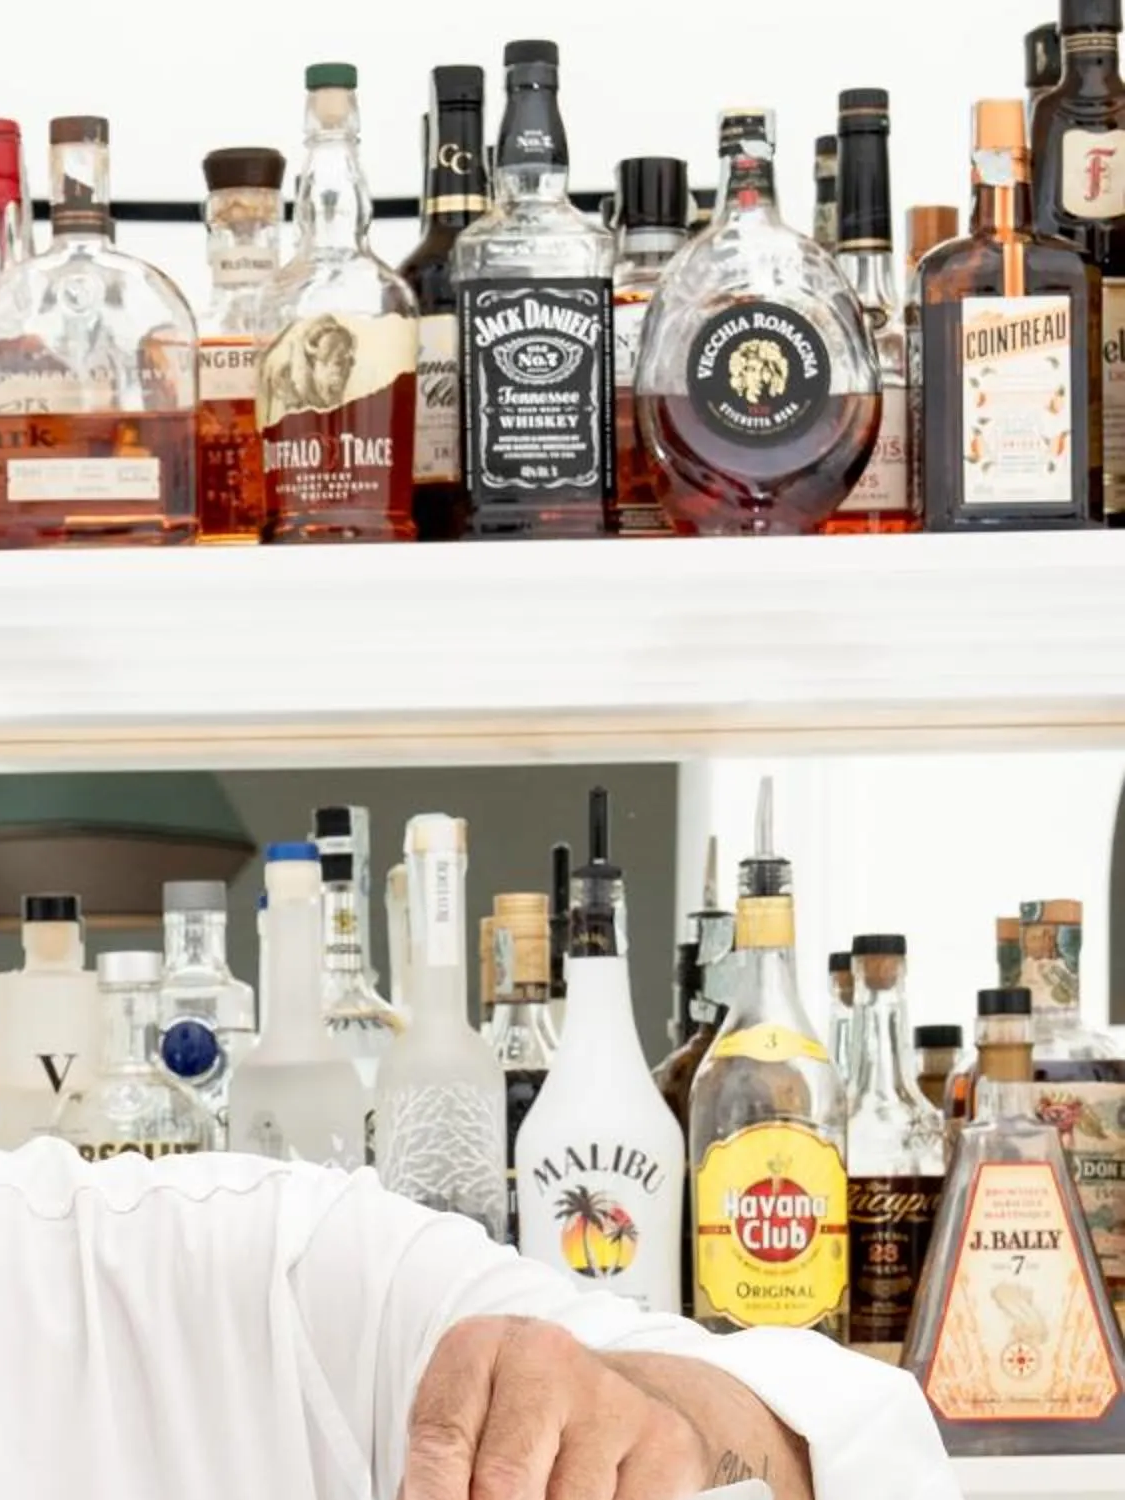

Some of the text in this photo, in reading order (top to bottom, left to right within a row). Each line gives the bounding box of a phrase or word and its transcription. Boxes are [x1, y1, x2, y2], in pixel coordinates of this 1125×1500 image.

[475, 298, 603, 348] JACK DANIEL'S
[966, 311, 1067, 361] COINTREAU
[199, 350, 257, 369] NGBR
[696, 315, 751, 380] VECCHIA
[753, 312, 820, 380] ROMAGNA
[497, 385, 581, 405] Tennessee
[499, 414, 580, 429] WHISKEY
[339, 432, 394, 469] TRACE
[36, 1053, 76, 1094] V
[532, 1142, 667, 1197] MALIBU
[724, 1188, 828, 1219] Havana
[742, 1218, 807, 1250] Club
[1011, 1255, 1026, 1276] 7
